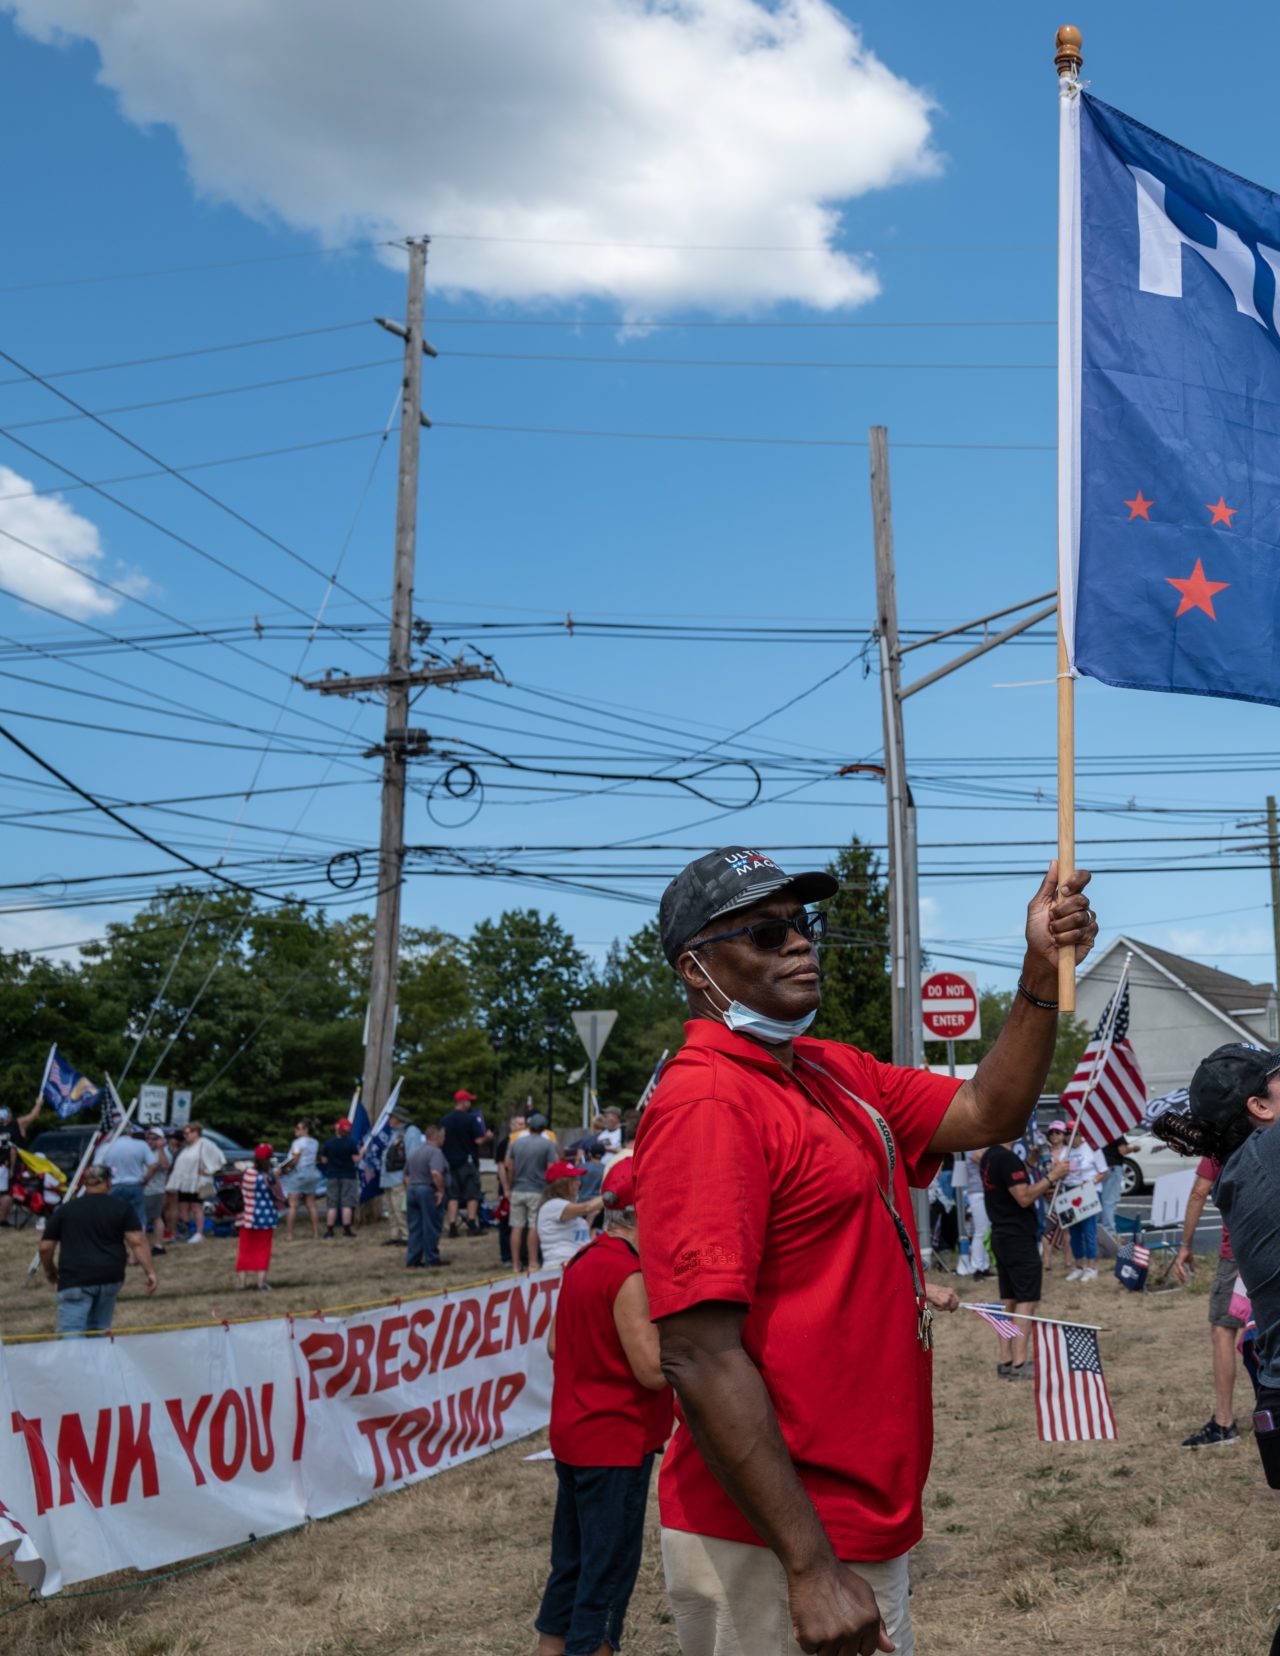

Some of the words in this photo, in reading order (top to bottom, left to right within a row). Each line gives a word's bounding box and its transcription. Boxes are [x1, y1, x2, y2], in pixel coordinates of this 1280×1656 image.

[927, 984, 943, 997] DO
[946, 984, 966, 997] NOT
[932, 1013, 966, 1027] ENTER
[875, 1117, 895, 1170] COWBOYS
[299, 1277, 561, 1401] PRESIDENT
[165, 1382, 275, 1487] YOU
[356, 1371, 527, 1489] TRUMP
